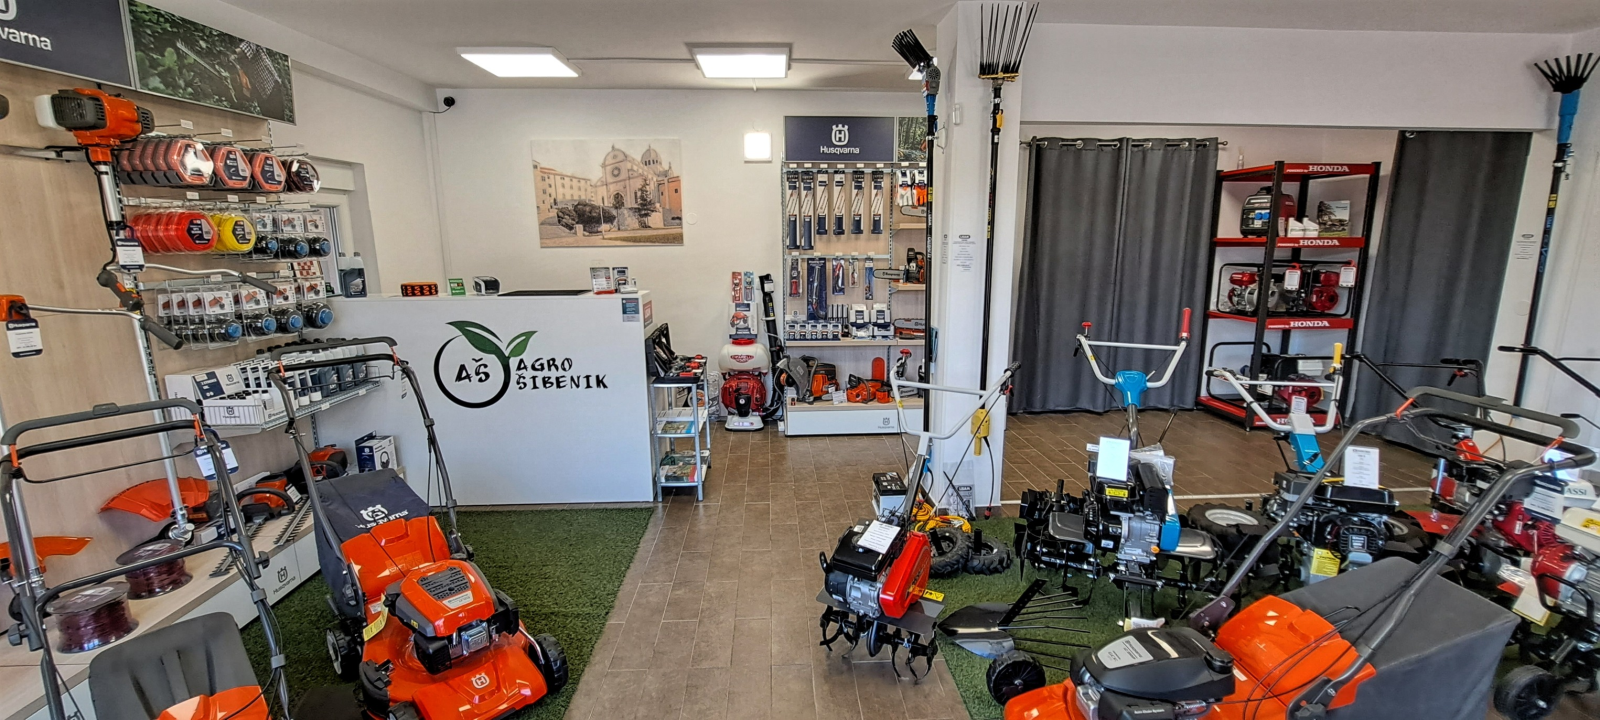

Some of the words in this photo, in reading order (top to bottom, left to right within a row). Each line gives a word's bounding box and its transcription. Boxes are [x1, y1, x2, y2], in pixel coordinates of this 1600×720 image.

[820, 146, 860, 155] Husqvarna
[1290, 320, 1330, 328] HONDA
[454, 357, 490, 383] AŠ
[515, 357, 573, 372] AGRO
[515, 373, 608, 390] ŠIBENIK
